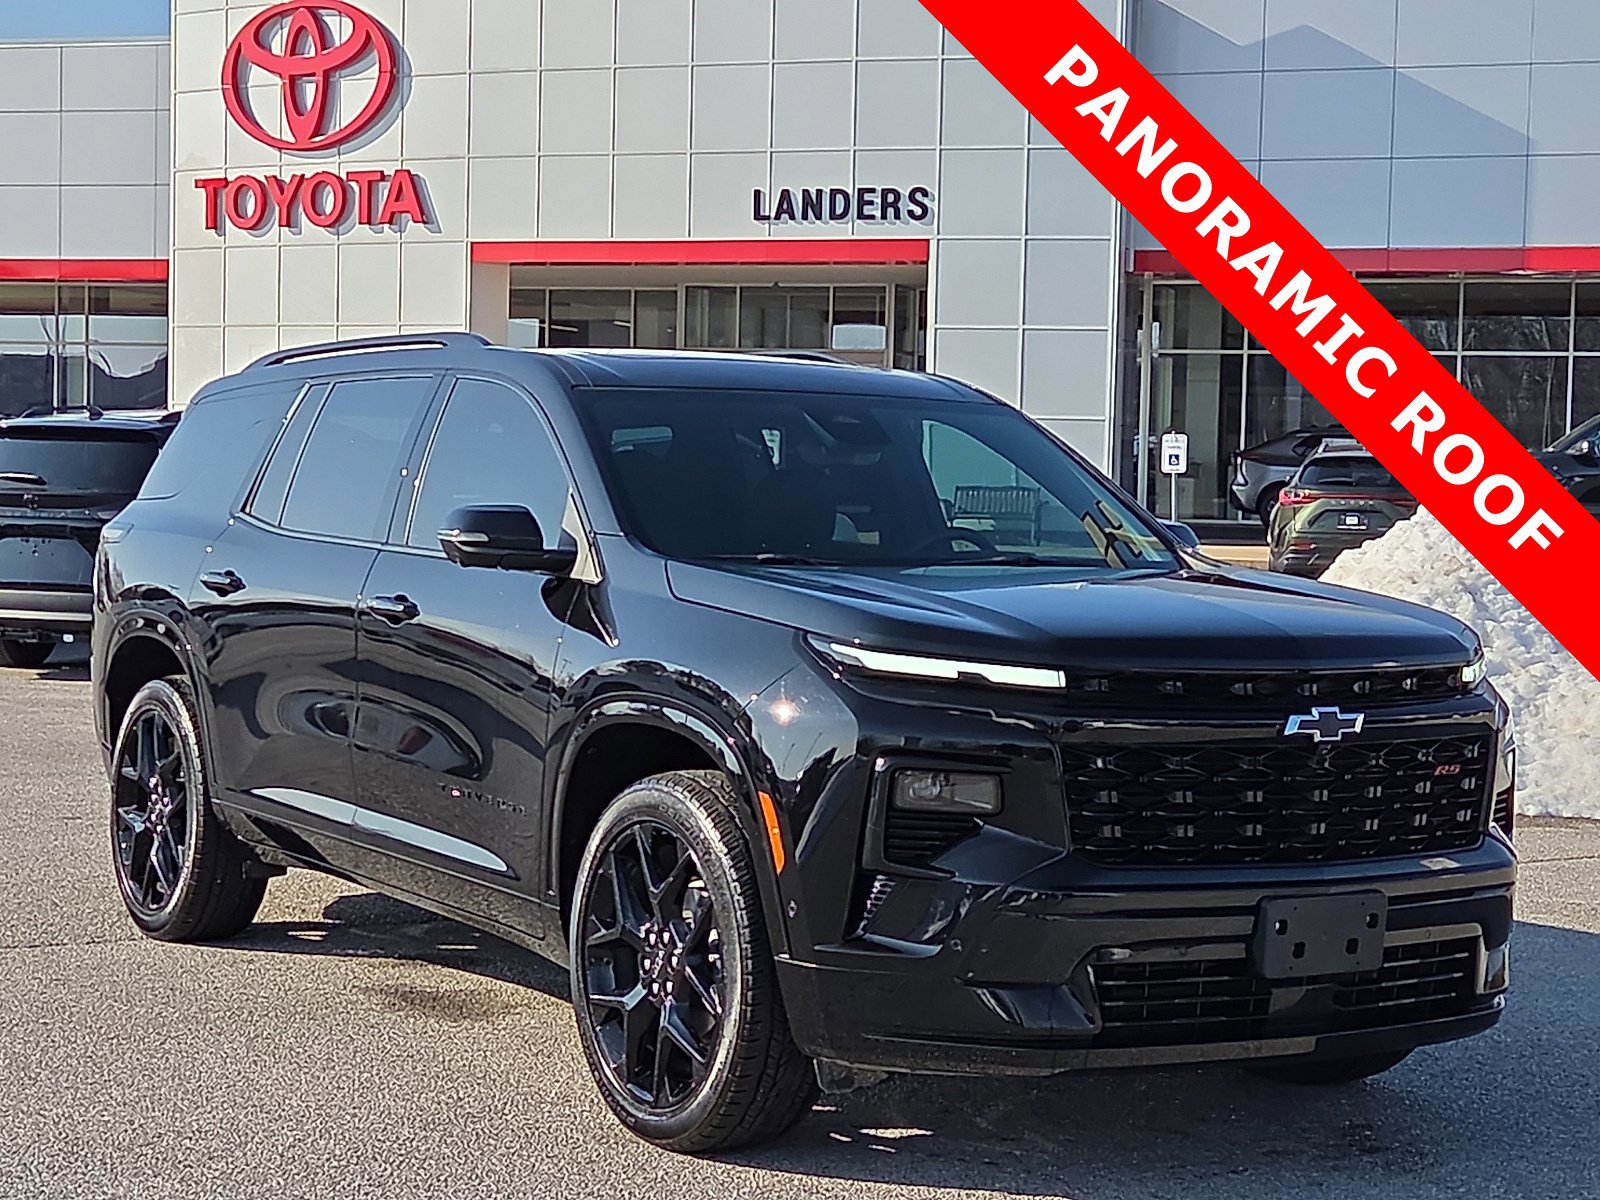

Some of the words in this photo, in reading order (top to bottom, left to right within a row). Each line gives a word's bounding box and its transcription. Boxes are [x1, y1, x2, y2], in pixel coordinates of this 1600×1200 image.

[194, 169, 428, 231] TOYOTA
[753, 186, 930, 221] LANDERS
[1433, 764, 1461, 776] RS
